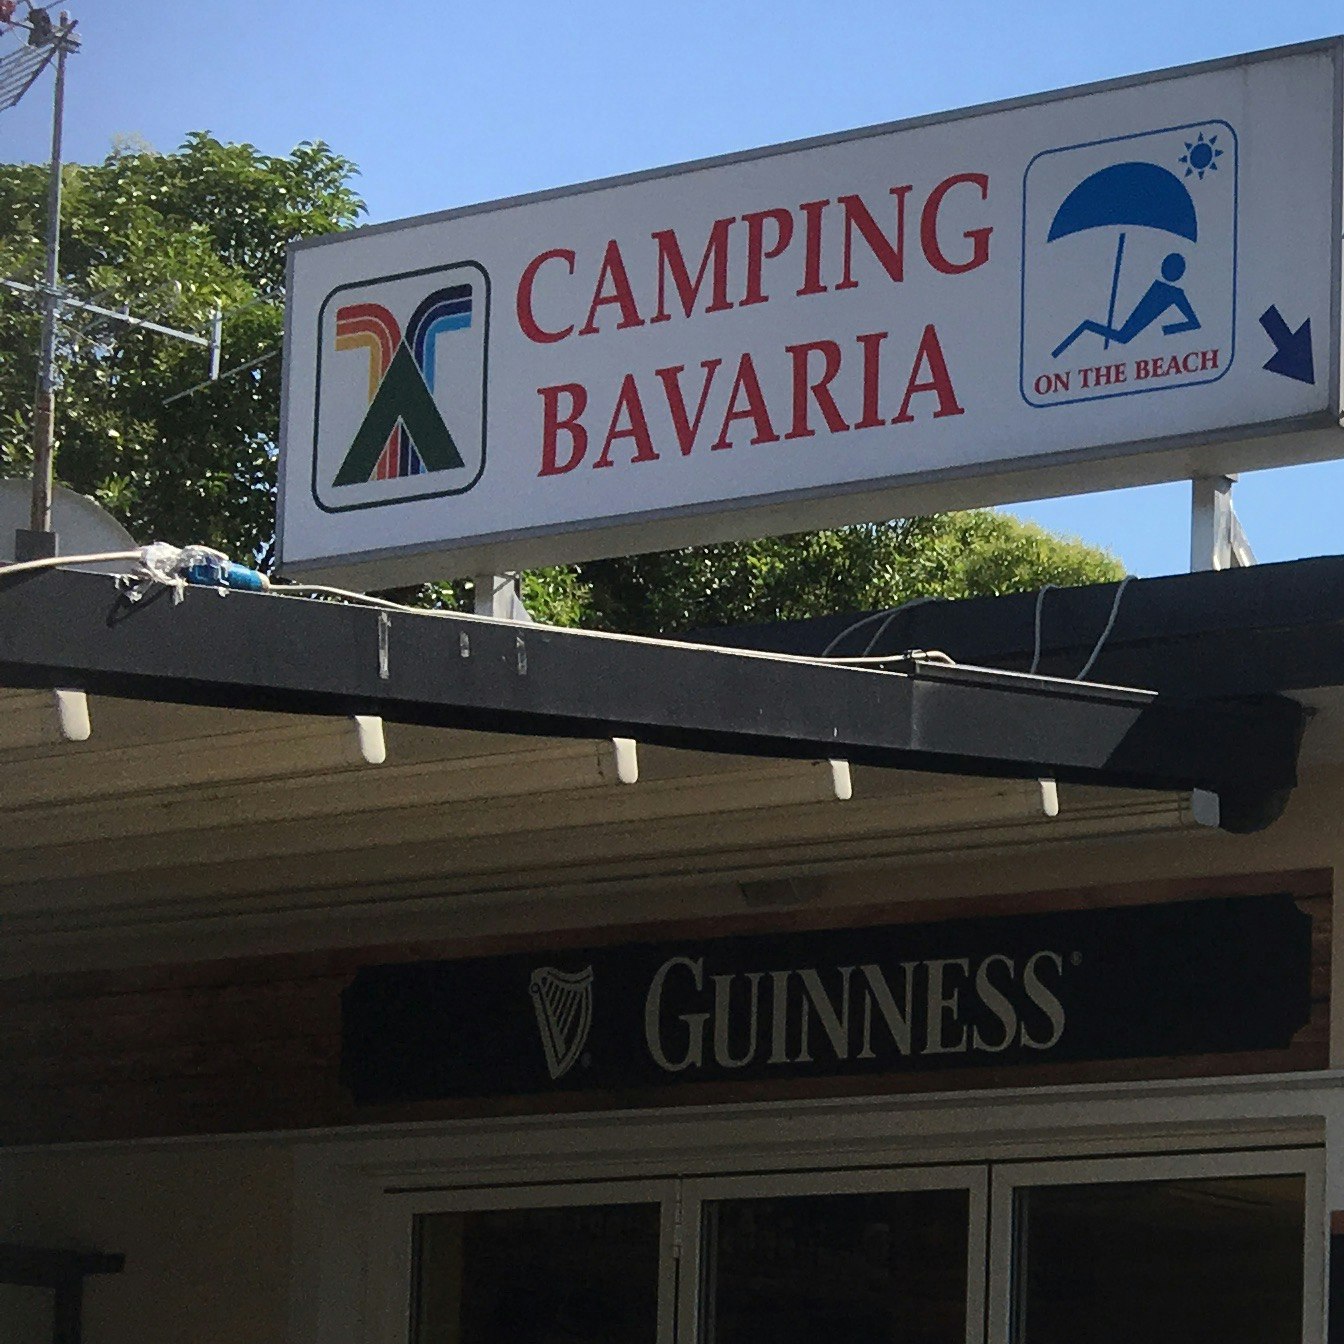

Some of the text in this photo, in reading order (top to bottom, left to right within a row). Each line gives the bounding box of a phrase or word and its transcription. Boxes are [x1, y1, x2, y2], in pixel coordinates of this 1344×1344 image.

[517, 171, 994, 344] CAMPING
[536, 323, 966, 477] BAVARIA
[1034, 350, 1219, 396] ON THE BEACH
